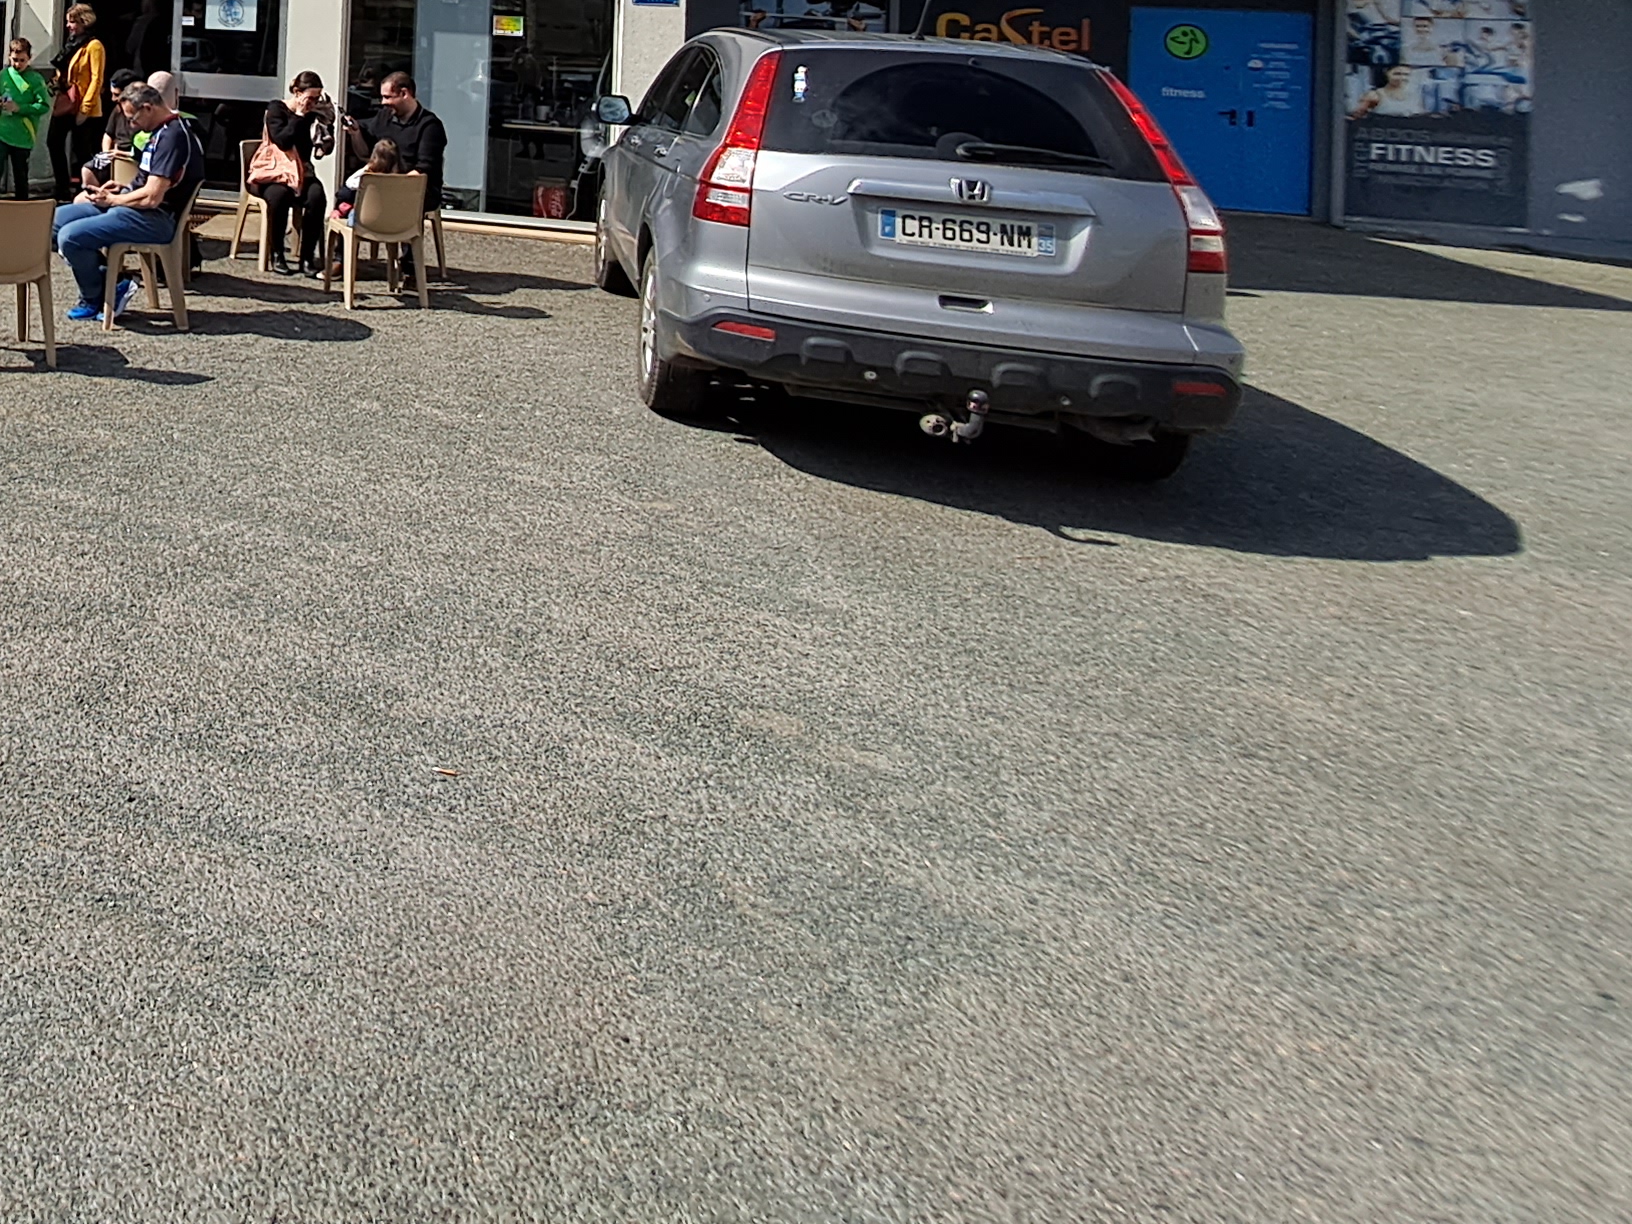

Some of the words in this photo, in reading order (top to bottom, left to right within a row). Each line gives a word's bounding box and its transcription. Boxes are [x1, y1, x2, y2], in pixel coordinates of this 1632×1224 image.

[1369, 142, 1498, 168] FITNESS
[783, 190, 848, 206] CR-V
[901, 214, 1032, 249] CR-669-NM
[1038, 239, 1054, 252] 35
